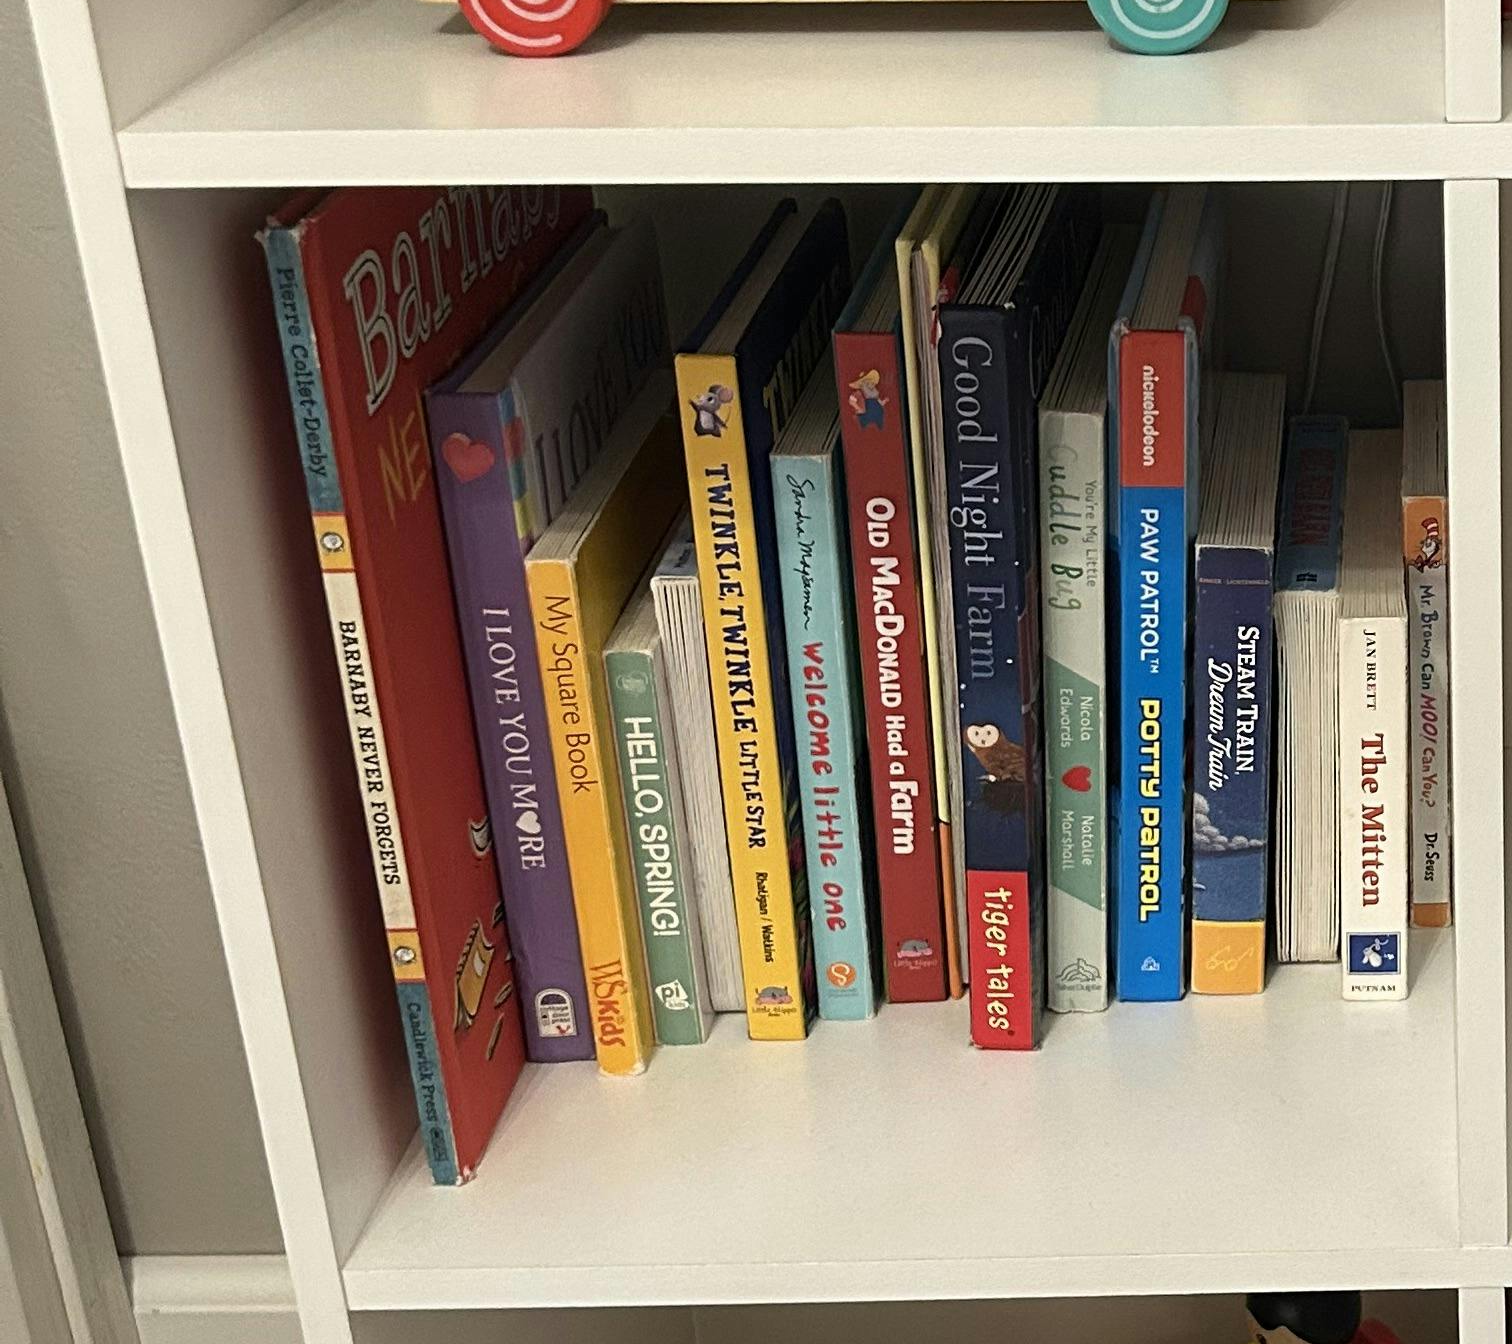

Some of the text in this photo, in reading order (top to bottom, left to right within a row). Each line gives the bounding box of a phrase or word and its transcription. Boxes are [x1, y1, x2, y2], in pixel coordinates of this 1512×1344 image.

[275, 267, 328, 478] Pierre Collet-Derby
[1142, 365, 1159, 467] nickelodeon
[951, 335, 1006, 681] Good Night Farm
[1048, 444, 1084, 611] Cuddle Bug
[1083, 479, 1099, 588] You're My Little
[1139, 508, 1160, 565] PAW
[483, 606, 533, 775] I LOVE YOU
[540, 595, 599, 794] My Square Book
[720, 604, 767, 849] TWINKLE LITTLE STAR
[1059, 688, 1074, 749] Edwards
[1079, 696, 1094, 743] Nicola
[1207, 657, 1233, 792] Dream Train
[1236, 625, 1260, 700] STEAM
[1363, 628, 1377, 711] JAN BRETT
[1420, 610, 1440, 808] Brown Can MOO! You?
[338, 620, 401, 886] BARNABY NEVER FORGETS
[885, 714, 919, 856] Had a Farm
[1360, 732, 1387, 908] The Mitten
[624, 716, 681, 937] HELLO, SPRING!
[813, 785, 847, 932] little one
[1061, 809, 1075, 871] Marshall
[1081, 814, 1095, 867] Natalie
[1424, 851, 1440, 883] Seuss
[981, 886, 1014, 1032] tiger tales
[406, 1002, 438, 1123] Candlewick Press
